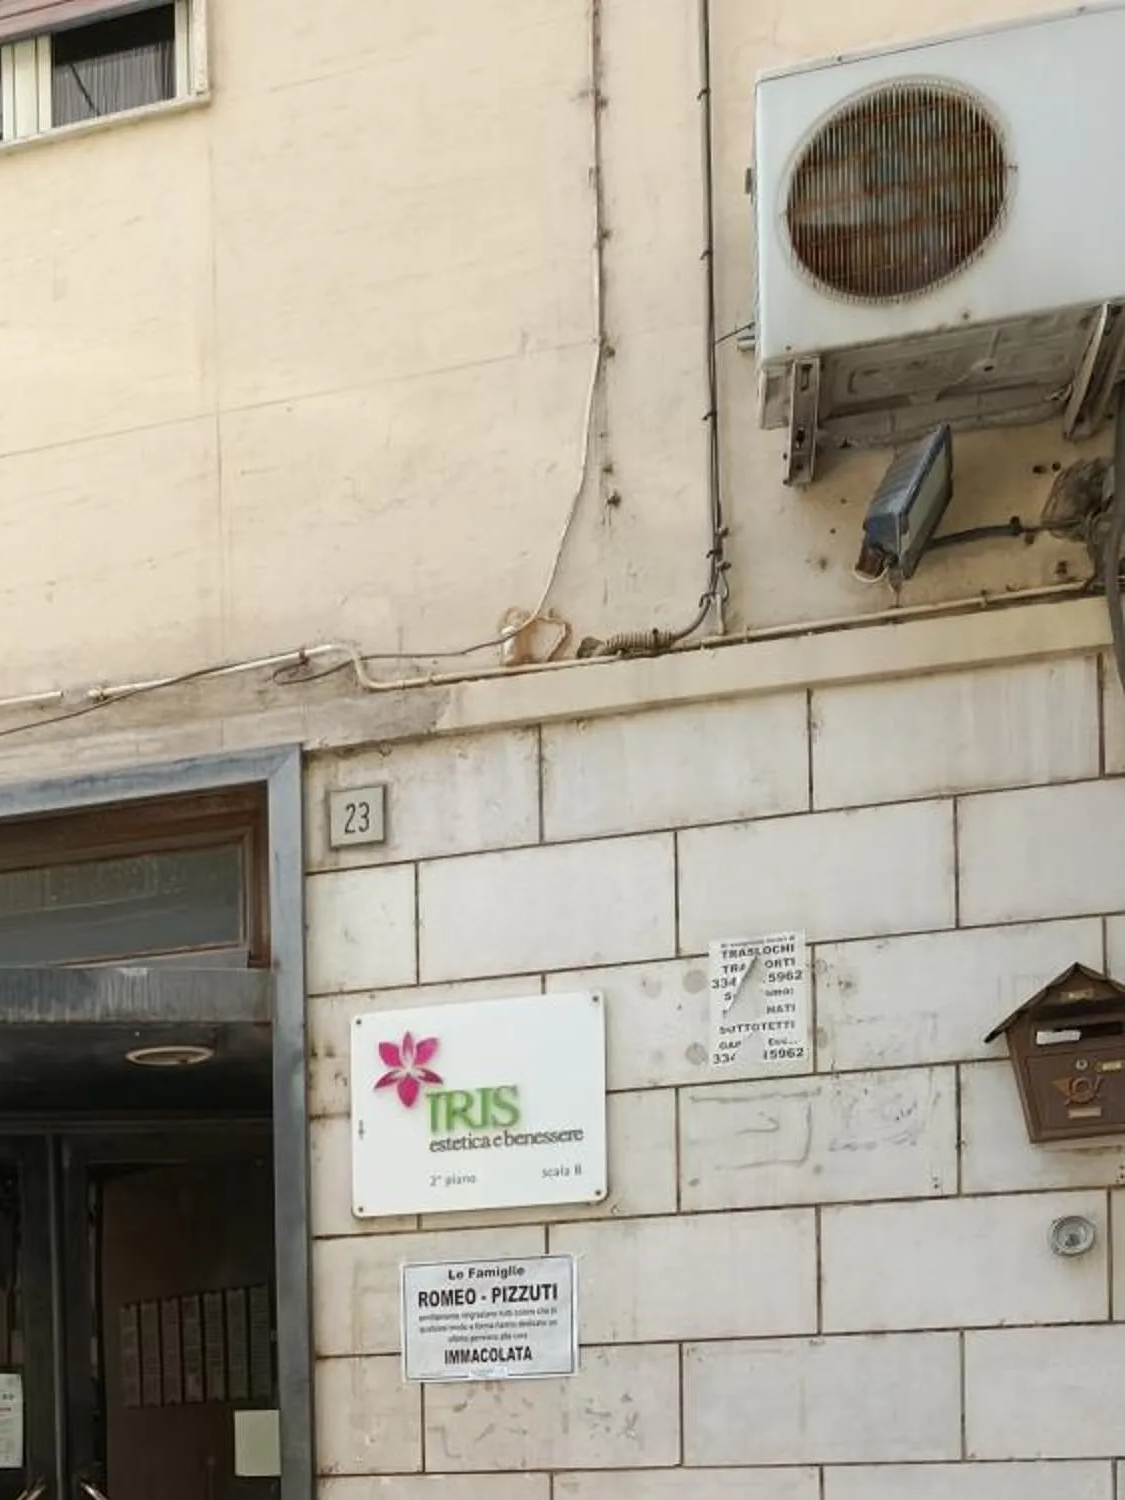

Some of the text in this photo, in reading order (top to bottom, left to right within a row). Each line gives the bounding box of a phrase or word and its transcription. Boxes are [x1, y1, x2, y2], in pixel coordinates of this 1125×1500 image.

[344, 801, 371, 835] 23
[721, 943, 795, 960] TRASLOCHI
[426, 1085, 522, 1134] IRIS
[429, 1127, 584, 1153] estetica e benessere
[445, 1173, 477, 1188] piano
[541, 1164, 571, 1179] scala
[448, 1265, 526, 1281] Le Famiglie
[418, 1288, 476, 1308] ROMEO
[492, 1283, 558, 1304] PIZZUTI
[444, 1346, 533, 1365] IMMACOLATA
